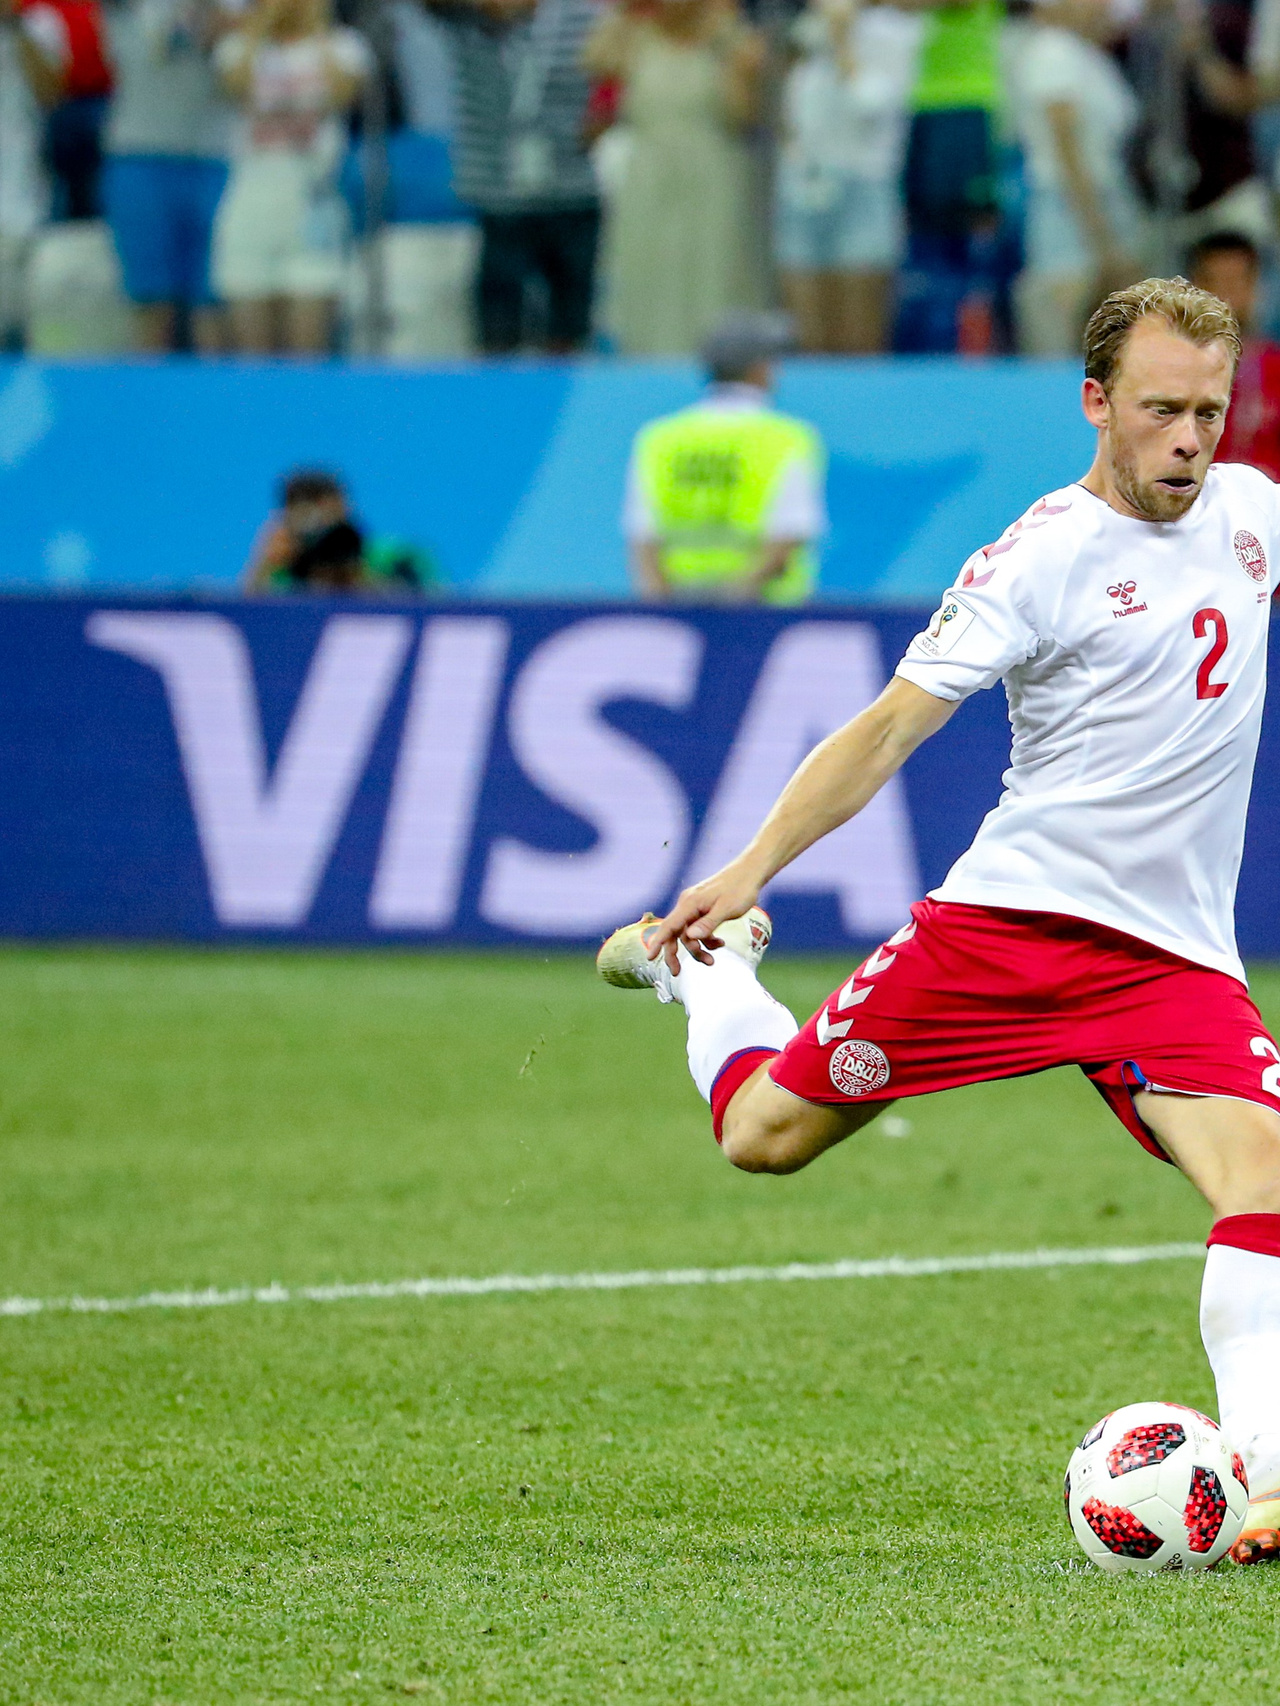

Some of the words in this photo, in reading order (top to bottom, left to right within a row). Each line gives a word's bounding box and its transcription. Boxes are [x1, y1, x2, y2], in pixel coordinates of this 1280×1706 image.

[1112, 602, 1148, 618] hummel
[1192, 608, 1229, 700] 2
[87, 611, 923, 935] VISA
[833, 1048, 849, 1080] DANSK
[841, 1055, 877, 1082] DBU
